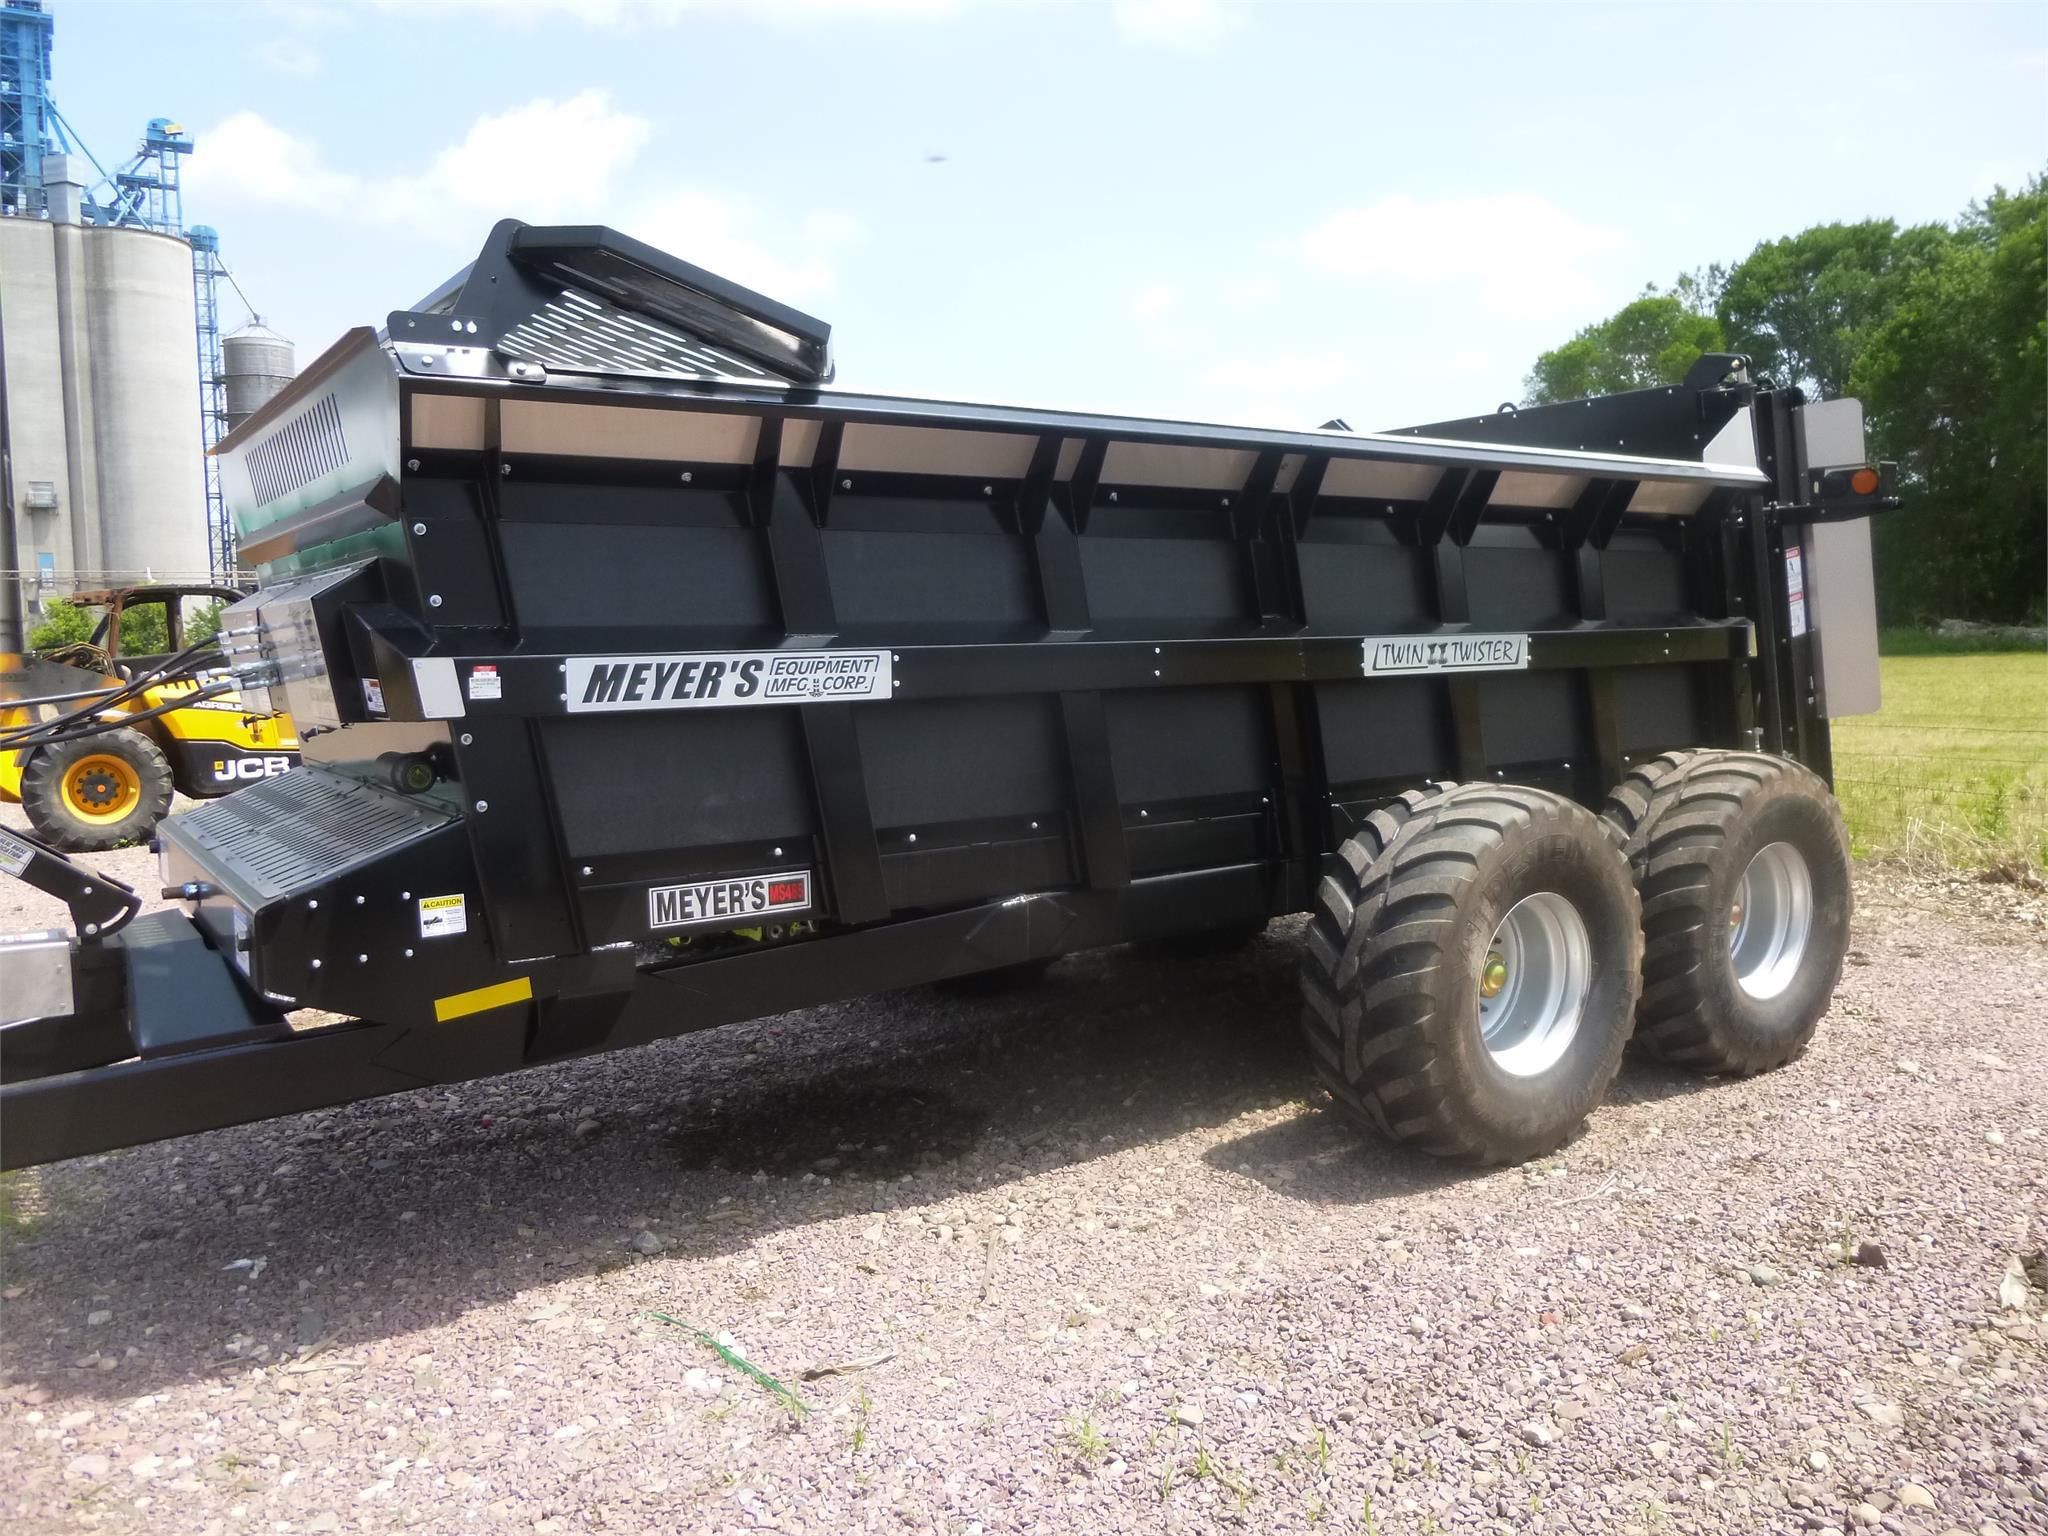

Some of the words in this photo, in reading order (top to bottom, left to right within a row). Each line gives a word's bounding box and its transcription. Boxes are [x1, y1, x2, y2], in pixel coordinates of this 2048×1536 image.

[1382, 643, 1423, 665] TWIN
[1452, 641, 1513, 662] TWISTER
[775, 658, 873, 675] EQUIPMENT
[582, 659, 764, 704] MEYER'S
[771, 676, 809, 692] MFG.
[822, 675, 867, 690] CORP.
[214, 756, 291, 781] JCB
[430, 898, 462, 908] CAUTION
[656, 881, 766, 923] MEYER'S
